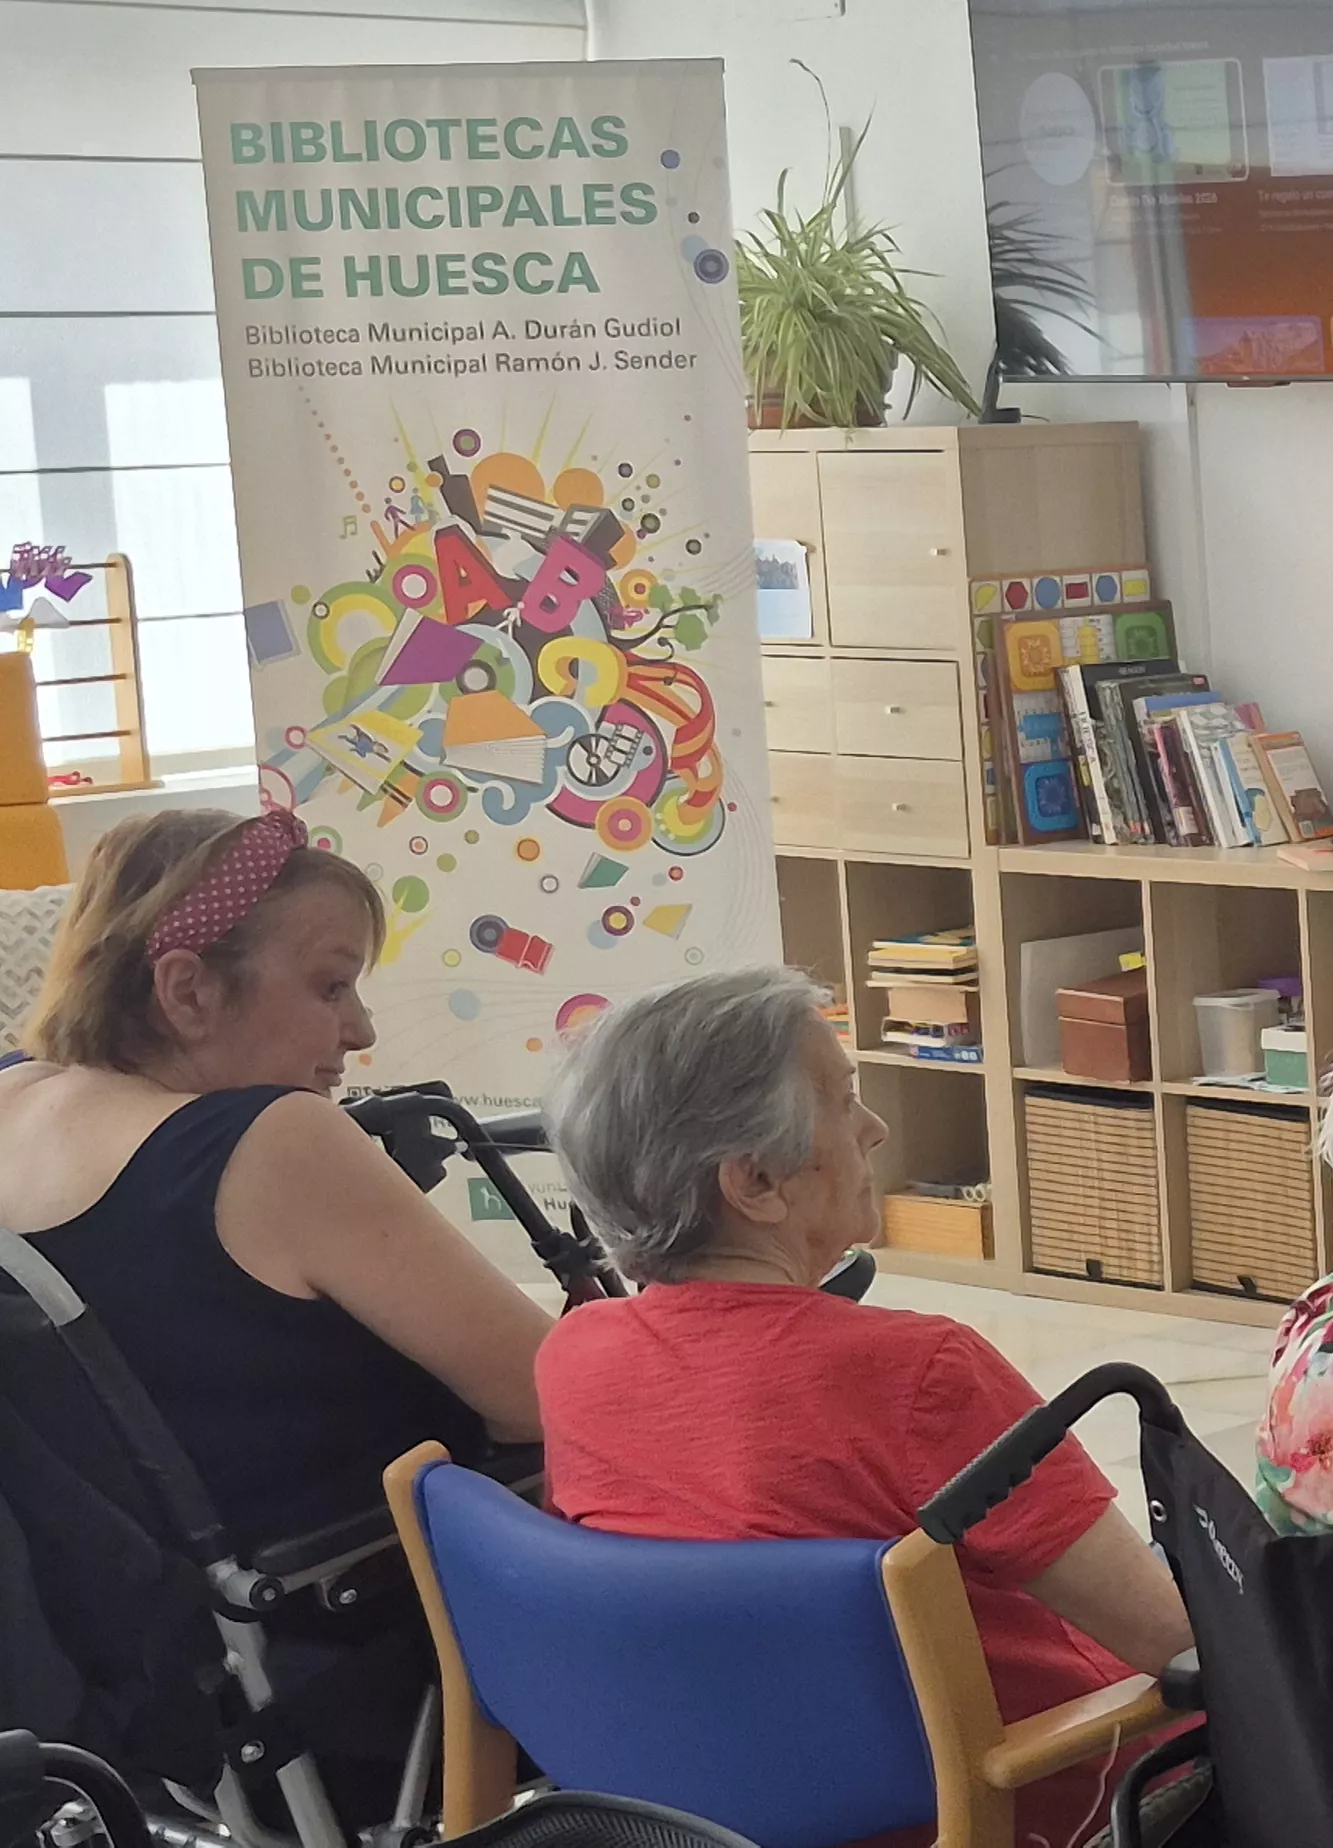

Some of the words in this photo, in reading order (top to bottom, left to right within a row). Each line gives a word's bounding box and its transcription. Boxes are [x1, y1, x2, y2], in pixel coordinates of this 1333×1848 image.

[229, 114, 630, 165] BIBLIOTECAS
[236, 181, 659, 233] MUNICIPALES
[242, 256, 324, 300] DE
[344, 251, 601, 299] HUESCA
[245, 324, 361, 346] Biblioteca
[367, 321, 486, 346] Municipal
[491, 320, 517, 341] A.
[524, 318, 598, 340] Durán
[603, 317, 682, 339] Gudiol
[248, 356, 364, 379] Biblioteca
[370, 353, 488, 378] Municipal
[495, 351, 582, 373] Ramón
[588, 350, 608, 372] J.
[613, 349, 699, 371] Sender
